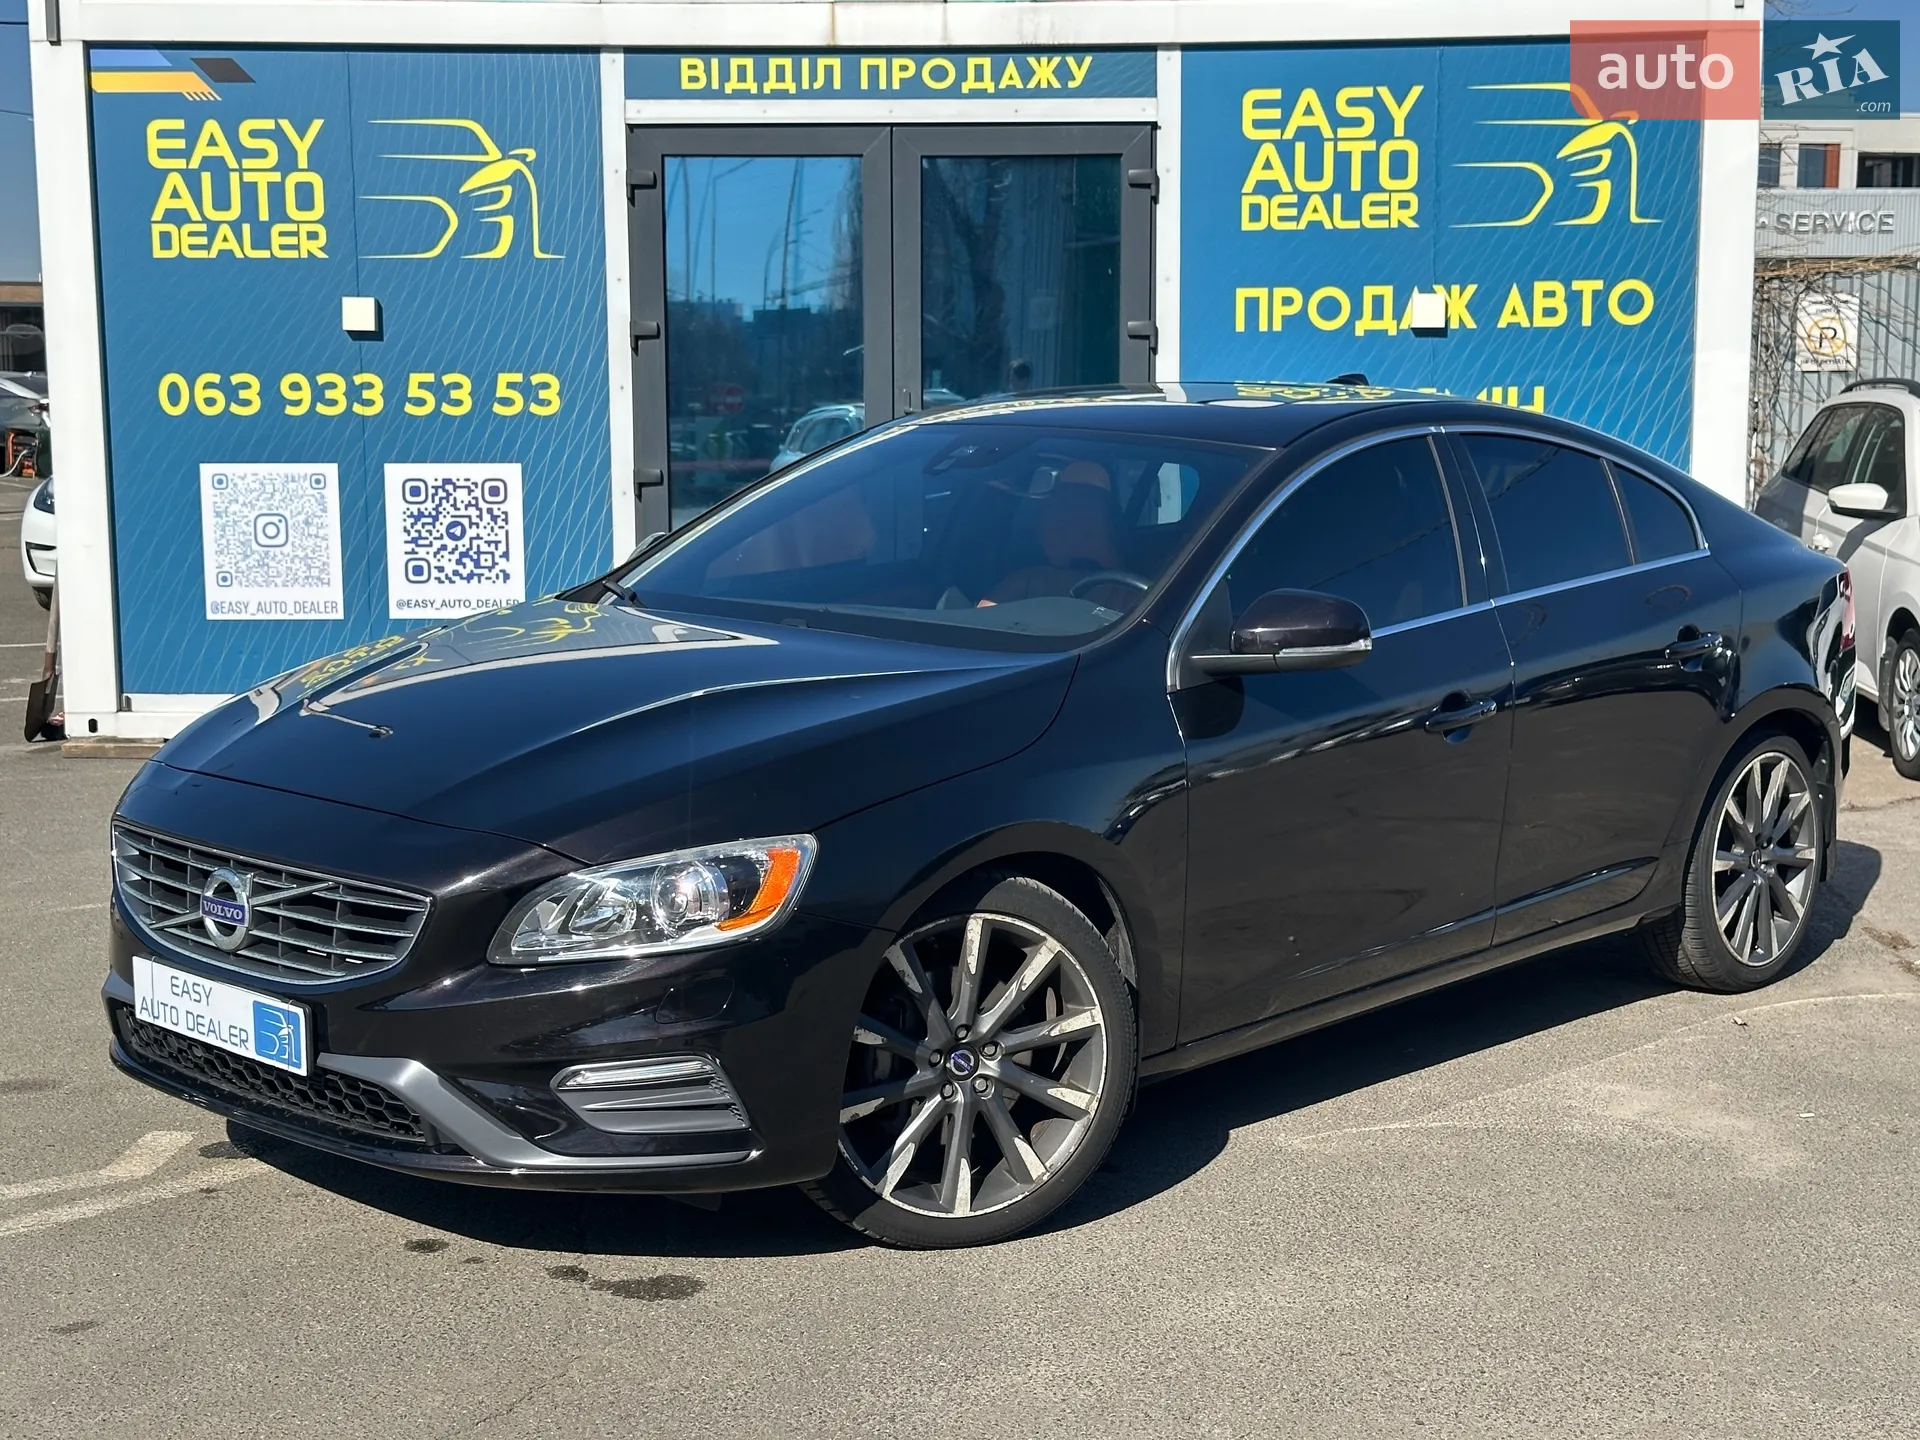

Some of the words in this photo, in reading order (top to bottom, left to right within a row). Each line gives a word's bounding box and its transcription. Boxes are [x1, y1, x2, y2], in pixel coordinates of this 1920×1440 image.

[680, 56, 842, 94] ВІДДІЛ
[860, 56, 1092, 94] ПРОДАЖУ
[1242, 85, 1424, 140] EASY
[146, 119, 324, 169] EASY
[1242, 140, 1419, 192] AUTO
[151, 172, 325, 221] AUTO
[1241, 193, 1419, 231] DEALER
[151, 223, 328, 259] DEALER
[1775, 210, 1895, 235] SERVICE
[1497, 279, 1654, 328] АВТО
[158, 373, 262, 416] 063
[280, 373, 384, 416] 933
[404, 373, 473, 416] 53
[492, 373, 561, 416] 53
[210, 600, 339, 616] @EASY_AUTO_DEALER
[203, 901, 243, 920] VOLVO
[170, 976, 213, 1007] EASY
[139, 997, 180, 1027] AUTO
[186, 1011, 249, 1050] DEALER
